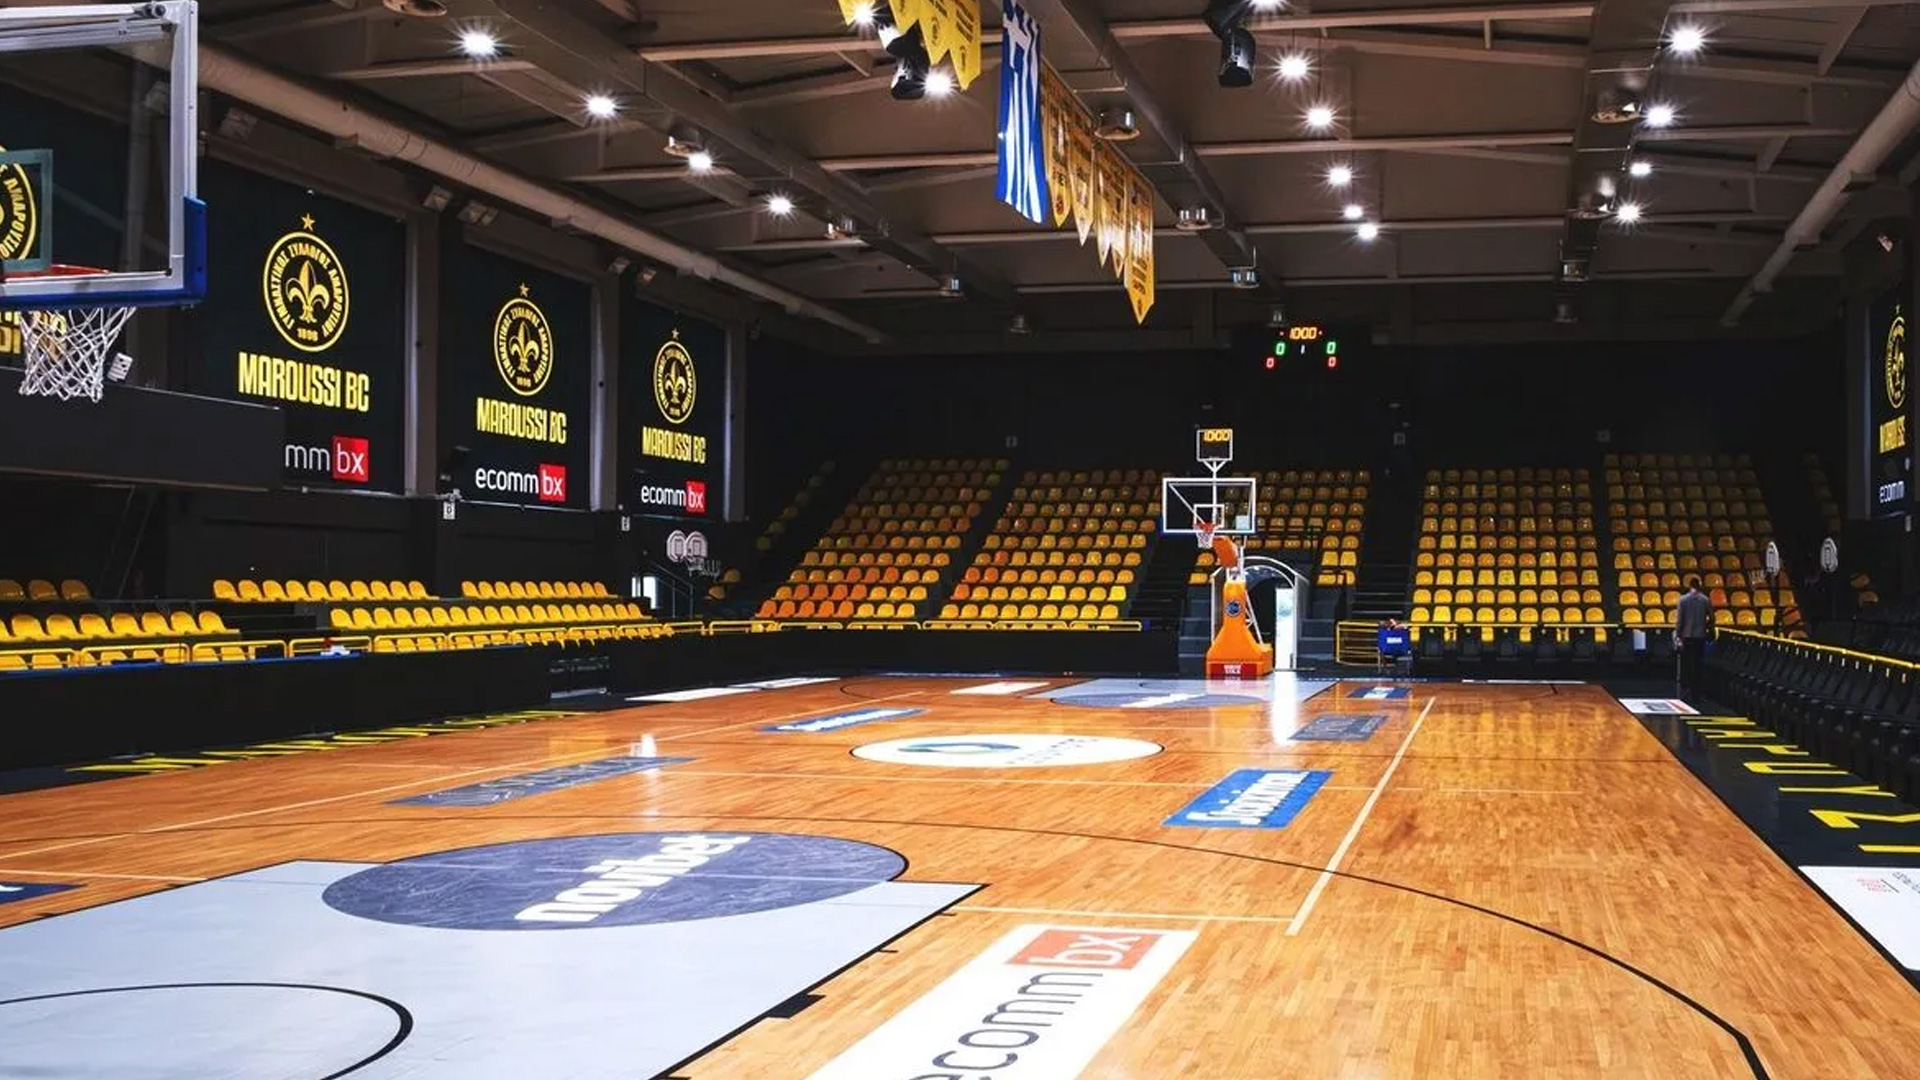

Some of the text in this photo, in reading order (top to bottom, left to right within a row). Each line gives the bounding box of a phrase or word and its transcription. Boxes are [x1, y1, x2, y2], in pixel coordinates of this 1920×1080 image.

[1266, 356, 1337, 369] 0 0
[1275, 341, 1337, 356] 0 0
[238, 352, 370, 412] MAROUSSI BC
[476, 397, 567, 445] MAROUSSI BC
[642, 426, 706, 464] MAROUSSI BC
